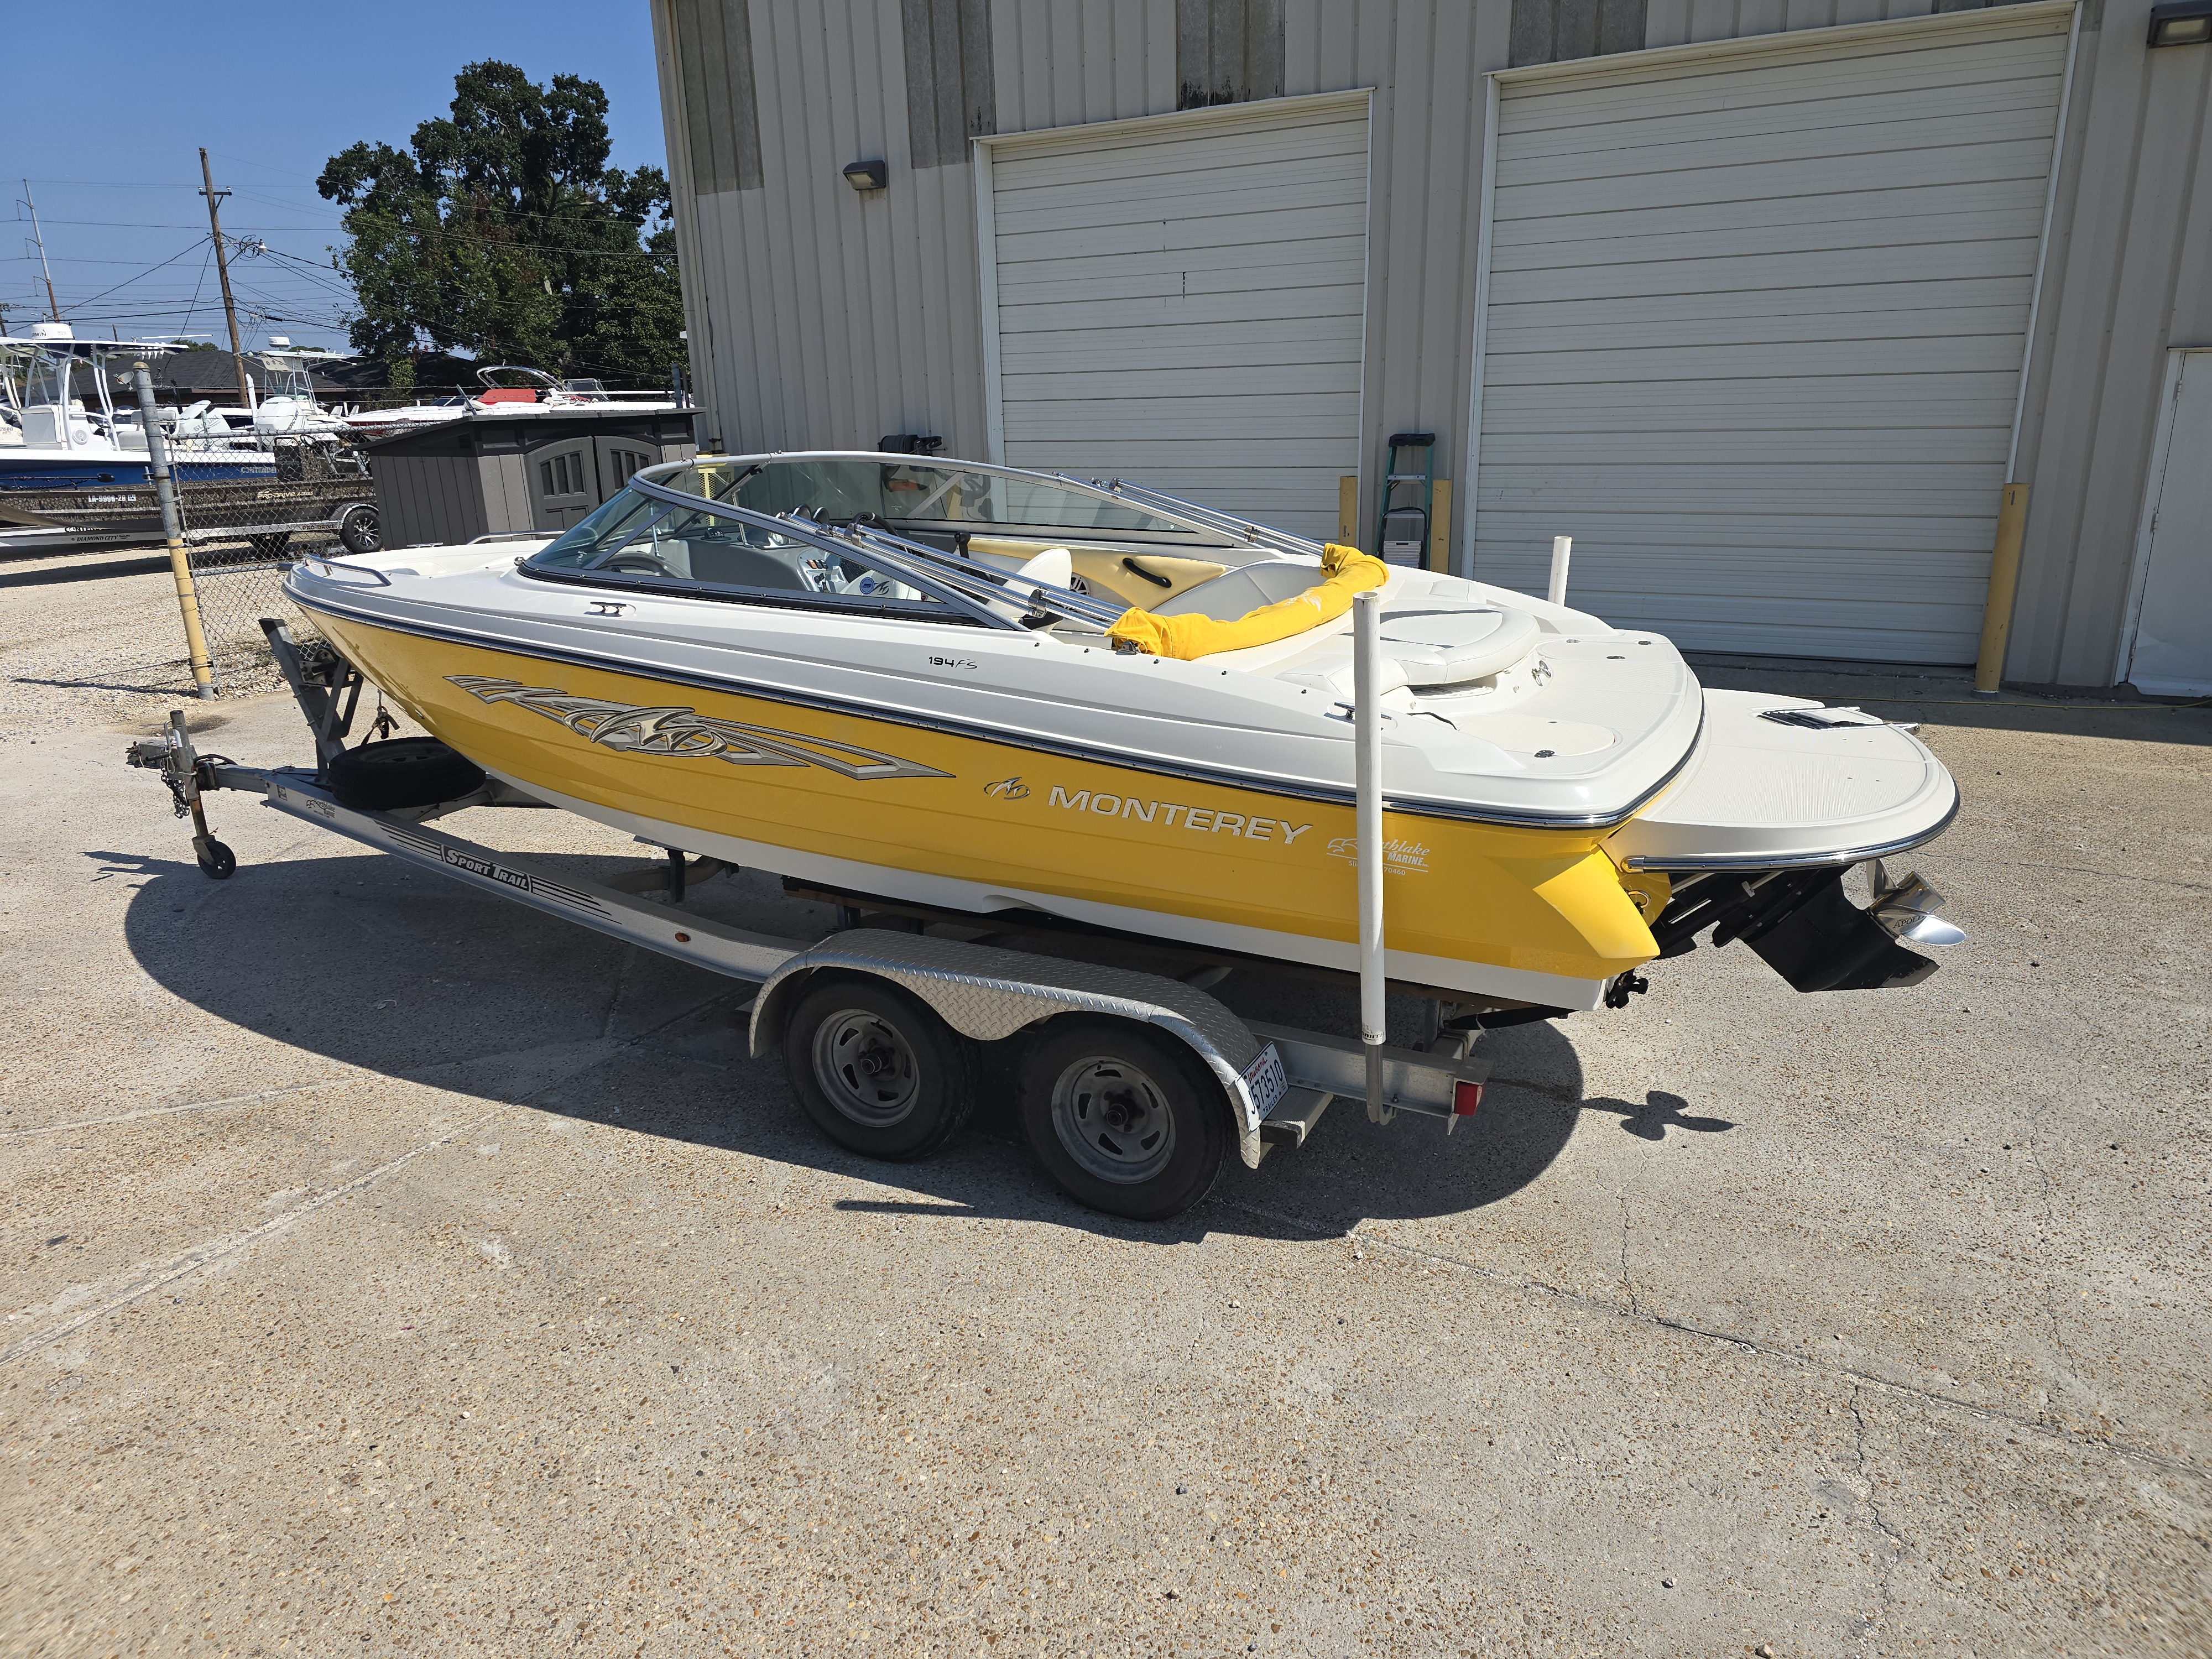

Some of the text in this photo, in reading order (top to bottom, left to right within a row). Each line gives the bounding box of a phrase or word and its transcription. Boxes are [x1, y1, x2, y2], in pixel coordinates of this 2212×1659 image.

[194, 415, 219, 431] SUUKI
[287, 408, 299, 430] ERCURY
[1048, 785, 1313, 844] MONTEREY
[1383, 839, 1430, 855] thlake
[1387, 852, 1423, 866] MARINE
[1384, 867, 1406, 876] 70460
[1893, 915, 1924, 929] APOLL
[1248, 1057, 1268, 1084] Louisiana
[1248, 1059, 1283, 1115] J573510
[1262, 1094, 1278, 1115] TRAILER
